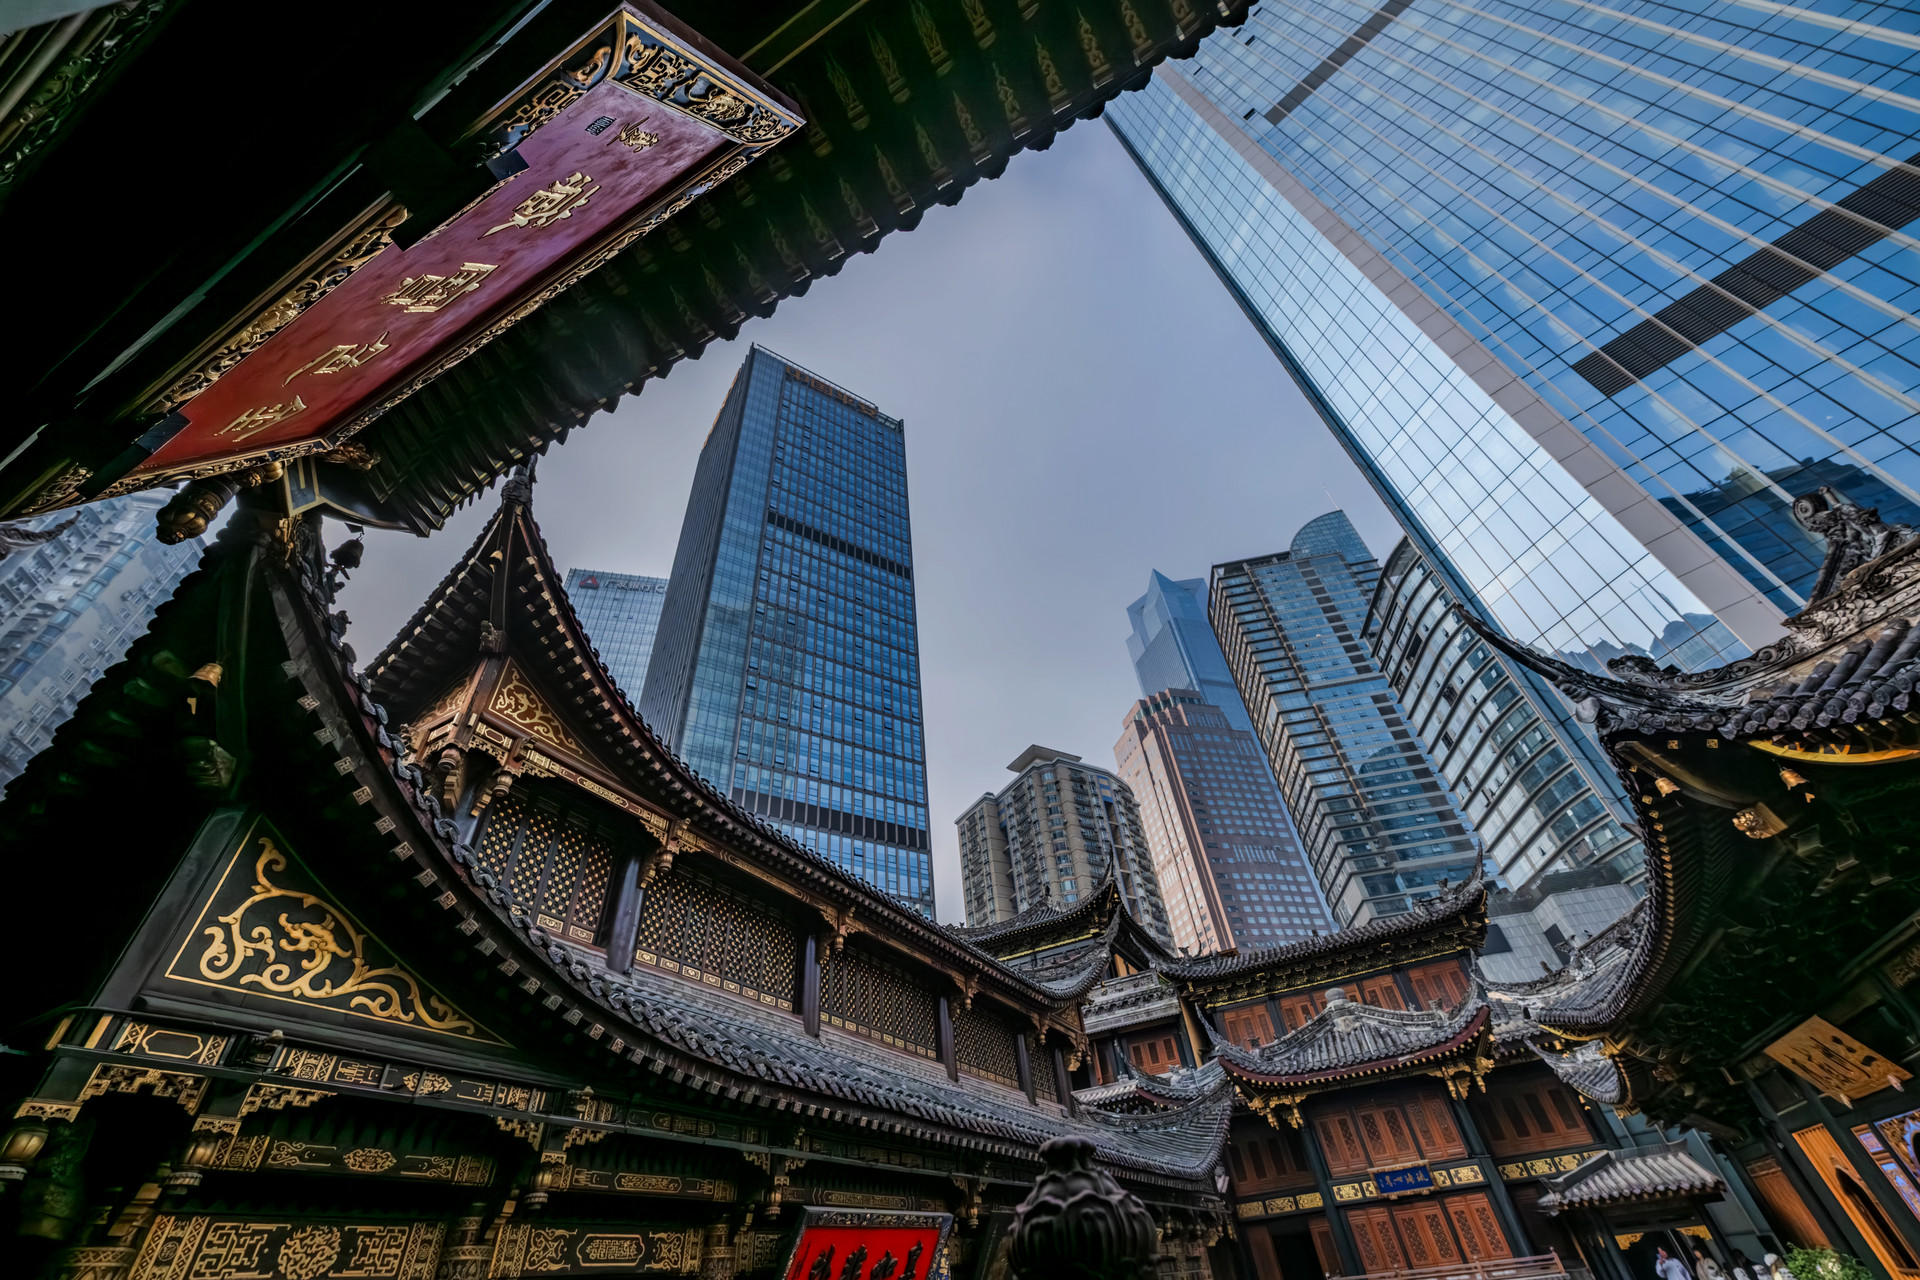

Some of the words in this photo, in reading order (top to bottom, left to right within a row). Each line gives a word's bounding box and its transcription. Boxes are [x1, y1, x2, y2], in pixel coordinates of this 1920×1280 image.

[213, 171, 602, 443] 金色寶藏
[785, 365, 879, 419] 中国平安
[604, 580, 652, 593] 广发银行
